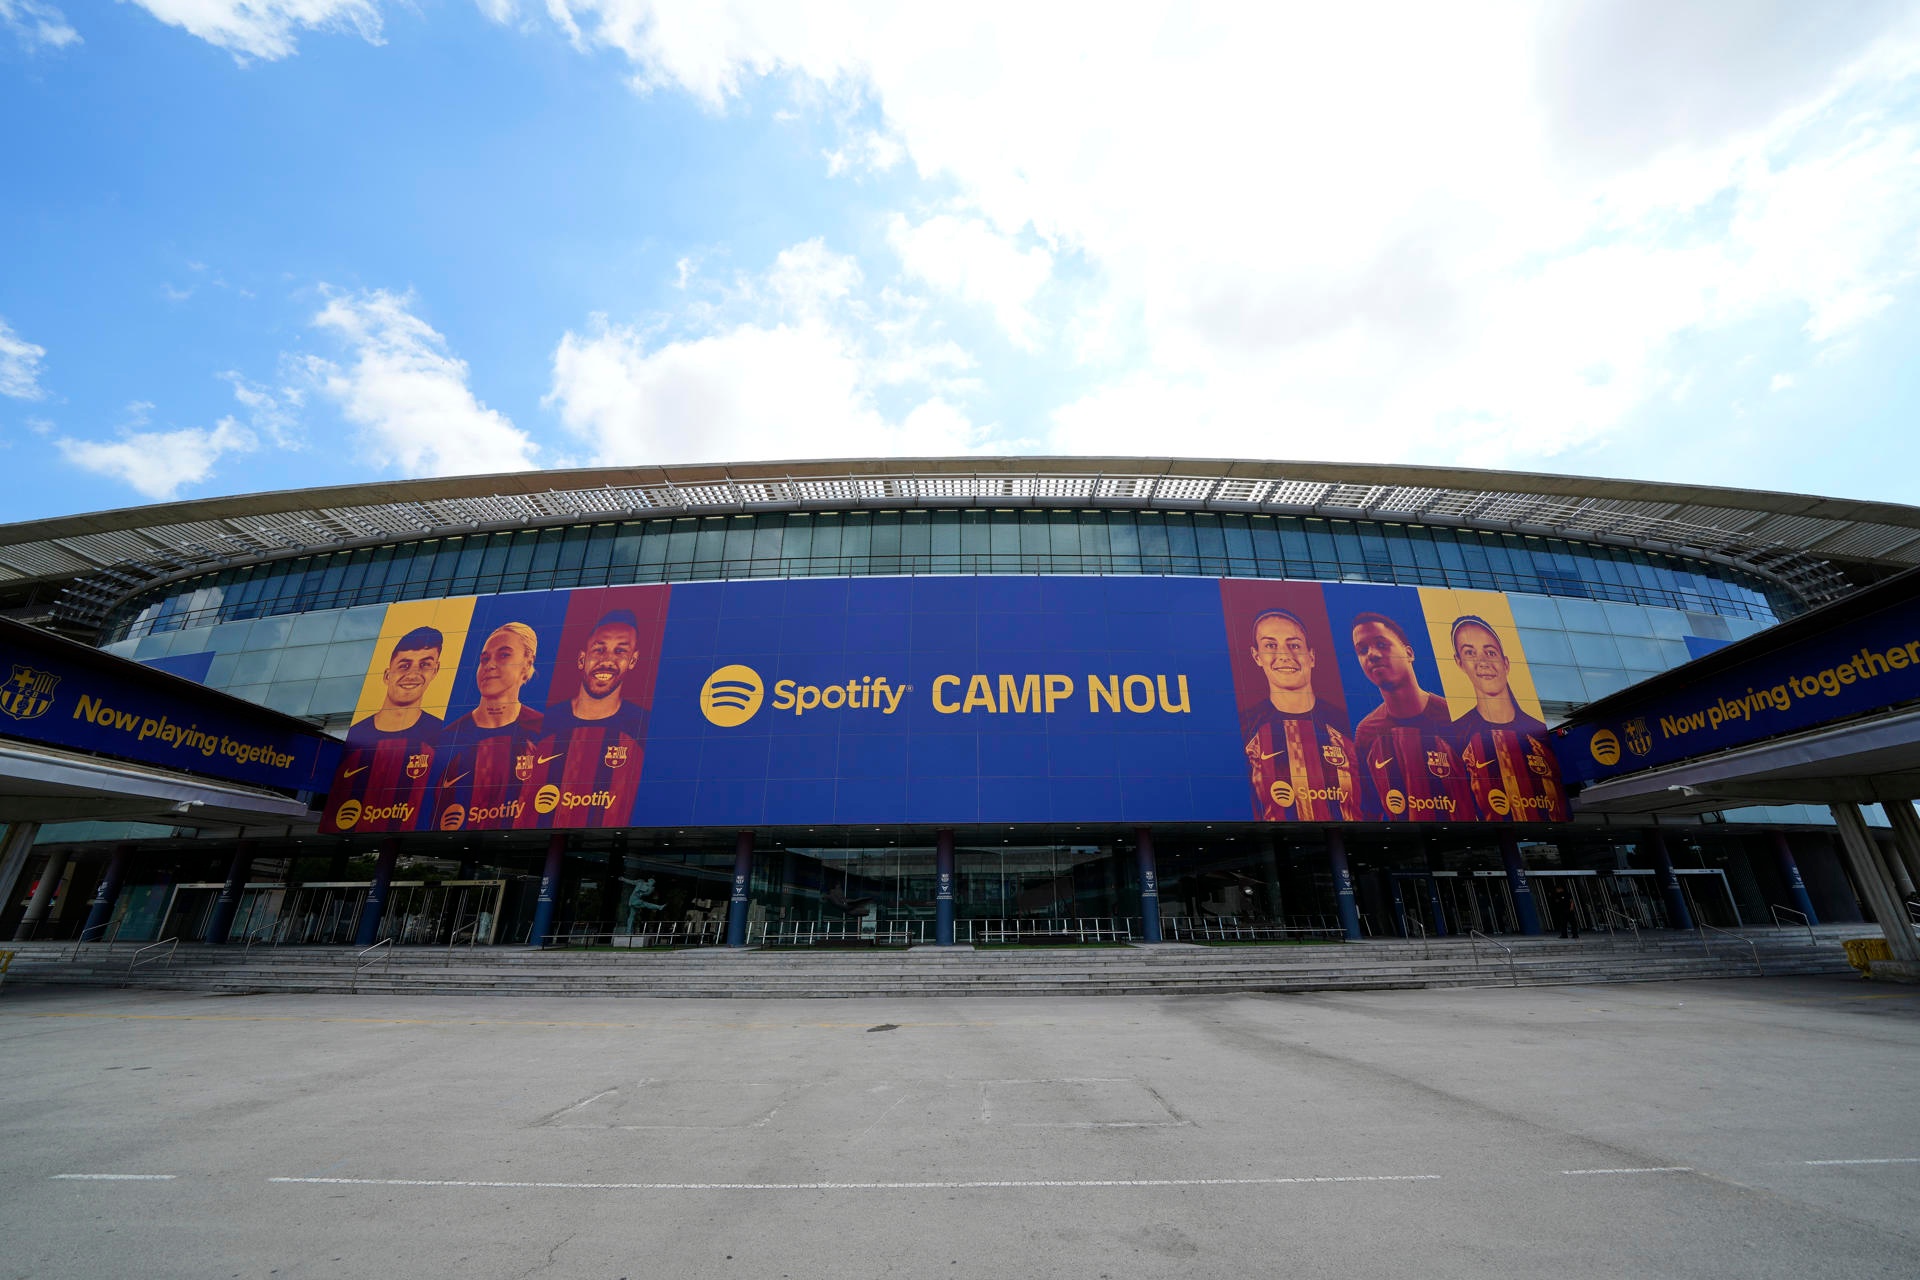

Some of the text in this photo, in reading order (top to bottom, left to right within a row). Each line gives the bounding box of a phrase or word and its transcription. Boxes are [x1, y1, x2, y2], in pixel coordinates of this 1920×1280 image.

[931, 674, 1074, 714] CAMP
[1087, 674, 1191, 714] NOU
[1660, 640, 1920, 739] Now playing together
[73, 694, 295, 769] Now playing together
[561, 790, 617, 809] Spotify
[1297, 786, 1349, 803] Spotify
[1408, 795, 1456, 812] Spotify
[1512, 794, 1555, 812] Spotify
[363, 803, 415, 823] Spotify
[468, 800, 526, 823] Spotify
